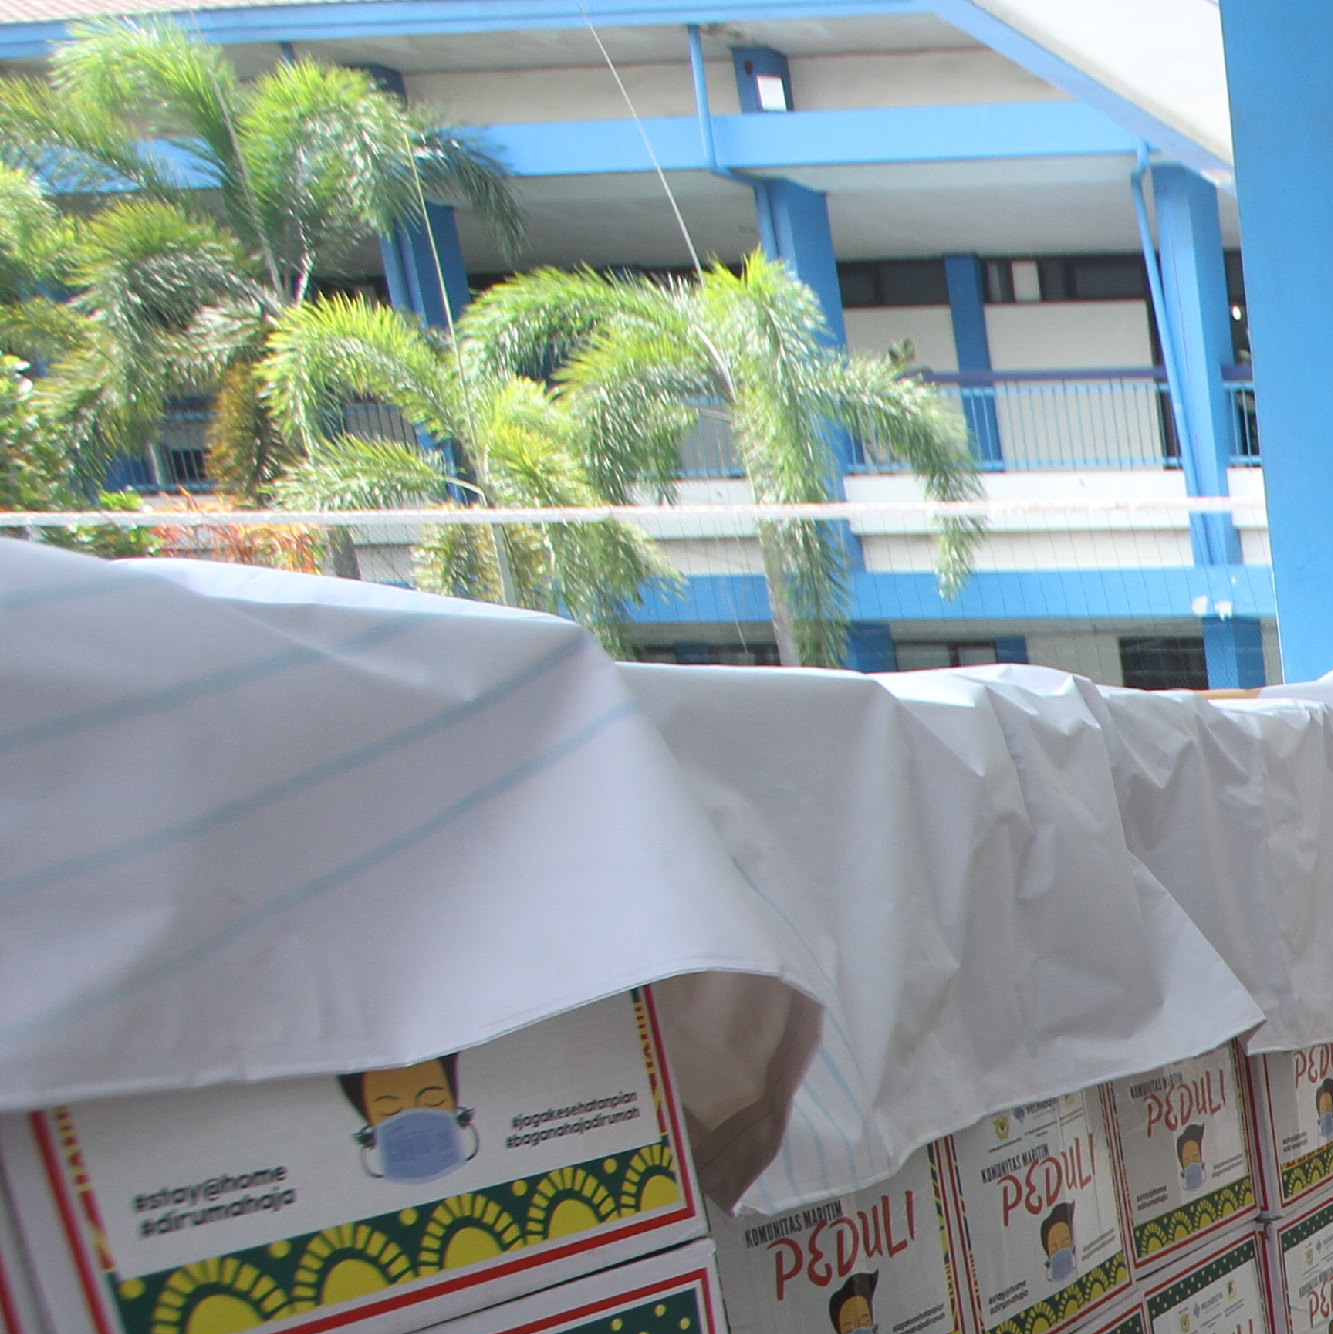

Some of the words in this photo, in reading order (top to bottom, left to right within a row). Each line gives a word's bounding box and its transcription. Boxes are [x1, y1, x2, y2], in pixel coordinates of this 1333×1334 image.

[1144, 1069, 1226, 1138] PEDULI
[134, 1162, 288, 1214] #stay@home
[981, 1154, 1022, 1184] KOMUNITAS
[1021, 1143, 1050, 1168] MARITIM
[997, 1133, 1096, 1227] PEDULI
[140, 1184, 295, 1240] #dirumahaja
[745, 1213, 802, 1249] KOMUNITAS
[802, 1199, 844, 1229] MARITIM
[767, 1190, 915, 1301] PEDULI
